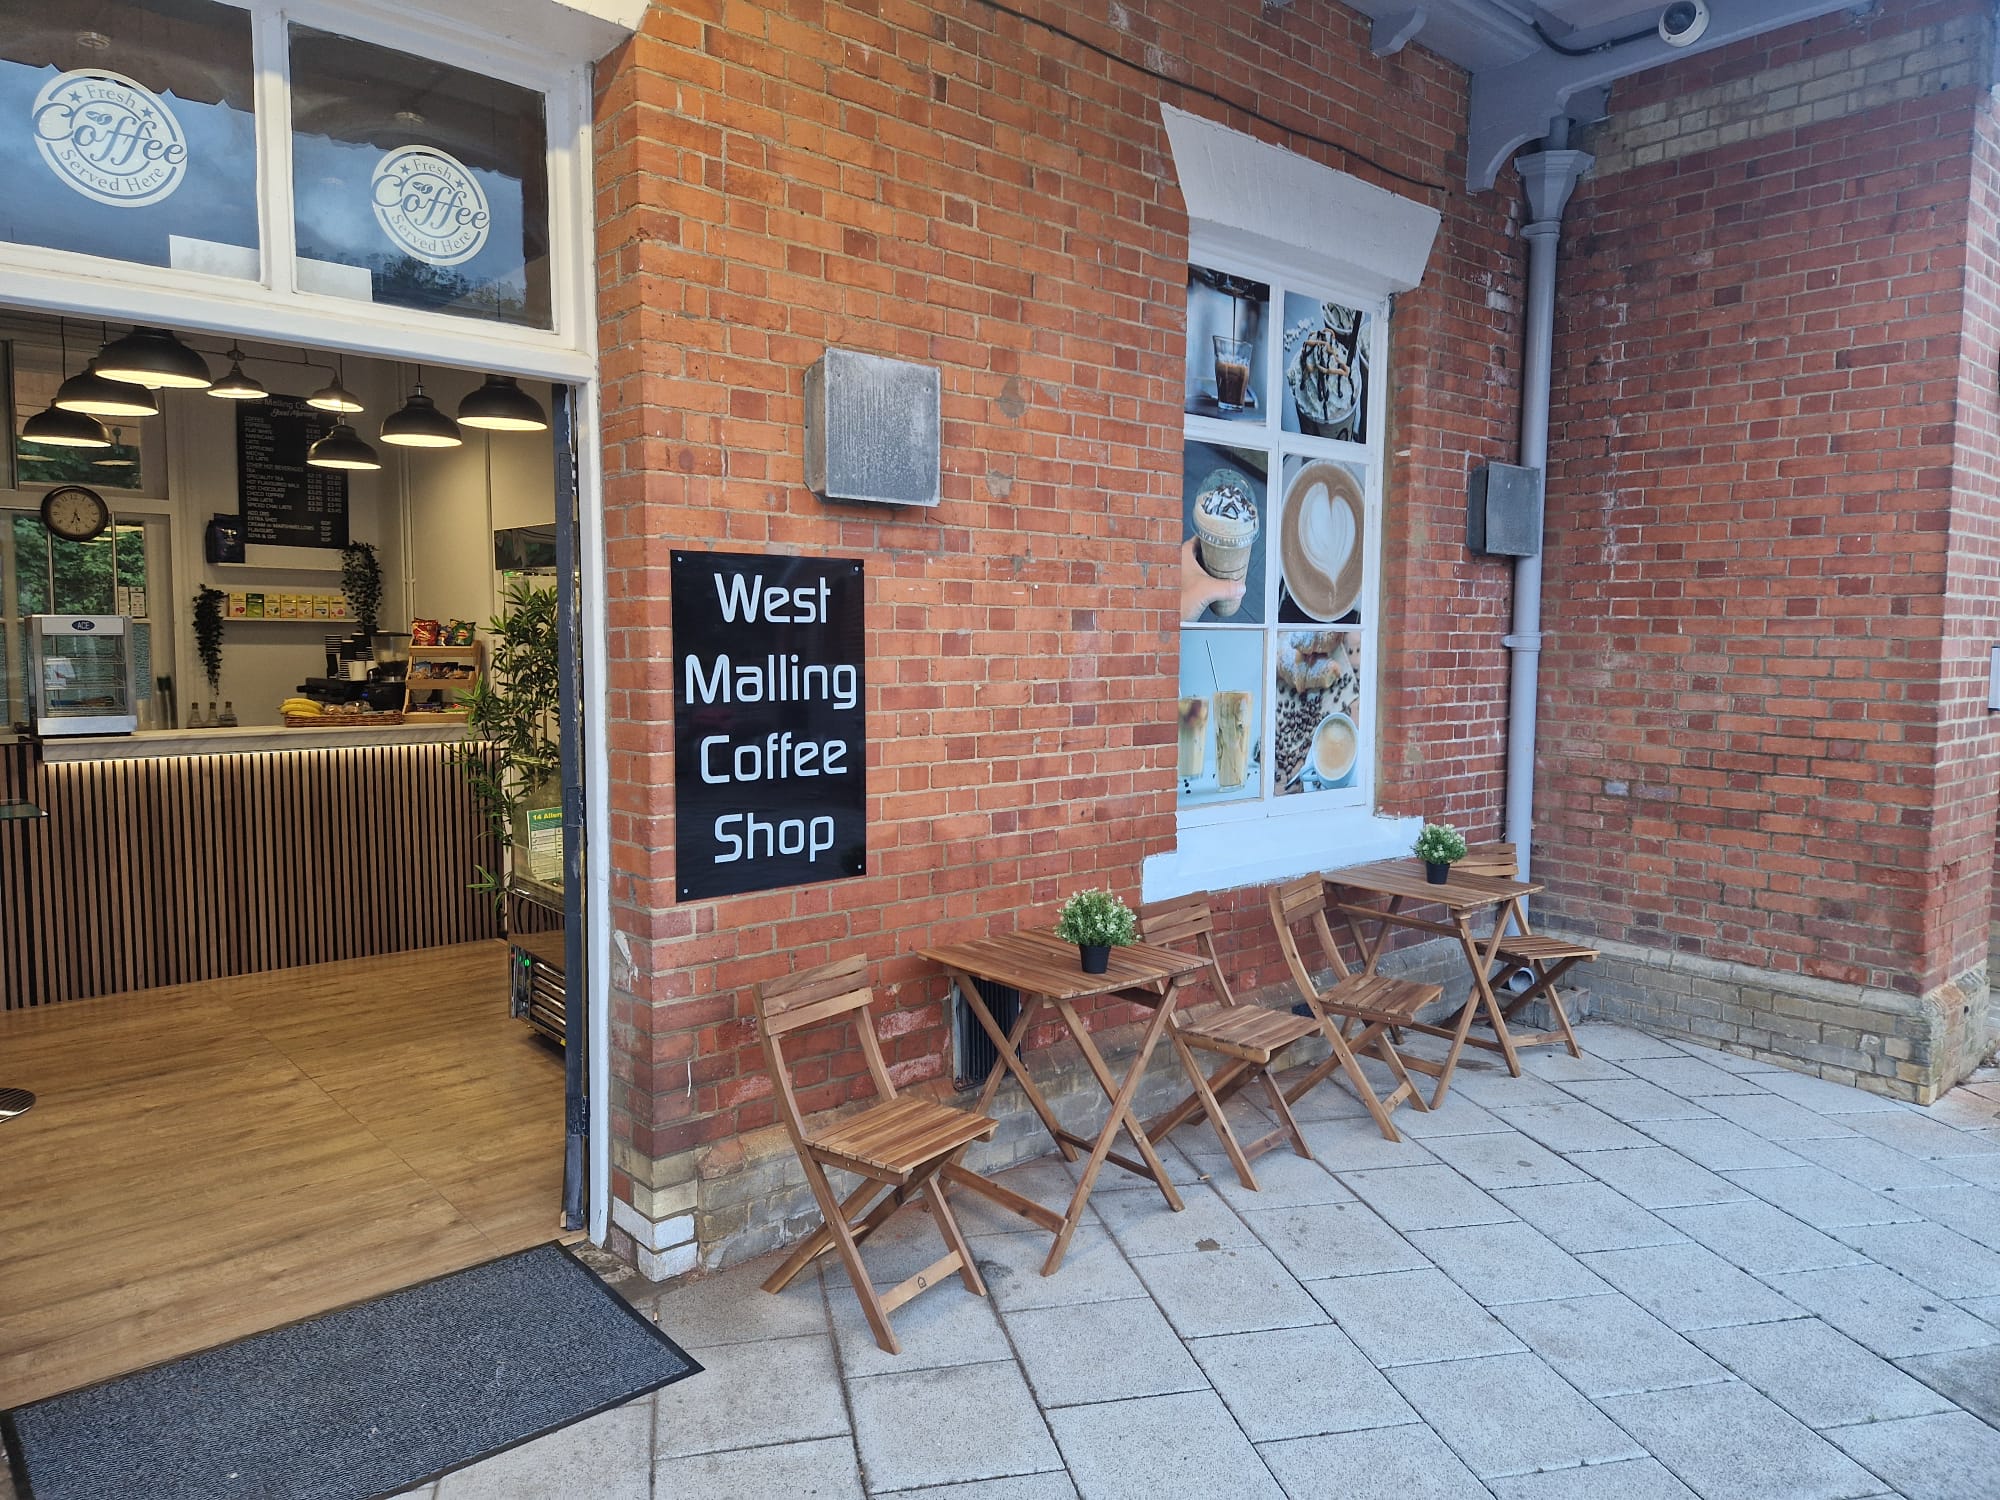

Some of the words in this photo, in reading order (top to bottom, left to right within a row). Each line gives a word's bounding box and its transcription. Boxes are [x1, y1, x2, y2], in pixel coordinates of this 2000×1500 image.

[84, 84, 137, 109] Fresh
[32, 102, 188, 166] Coffee
[60, 149, 121, 192] Served
[125, 167, 164, 192] Here
[413, 158, 452, 180] Fresh
[371, 174, 489, 230] Coffee
[391, 214, 437, 252] Served
[441, 232, 471, 252] Here
[713, 572, 831, 624] West
[77, 621, 90, 630] ACE
[685, 654, 857, 710] Malling
[700, 731, 848, 784] Coffee
[533, 813, 542, 821] 14
[714, 812, 835, 864] Shop
